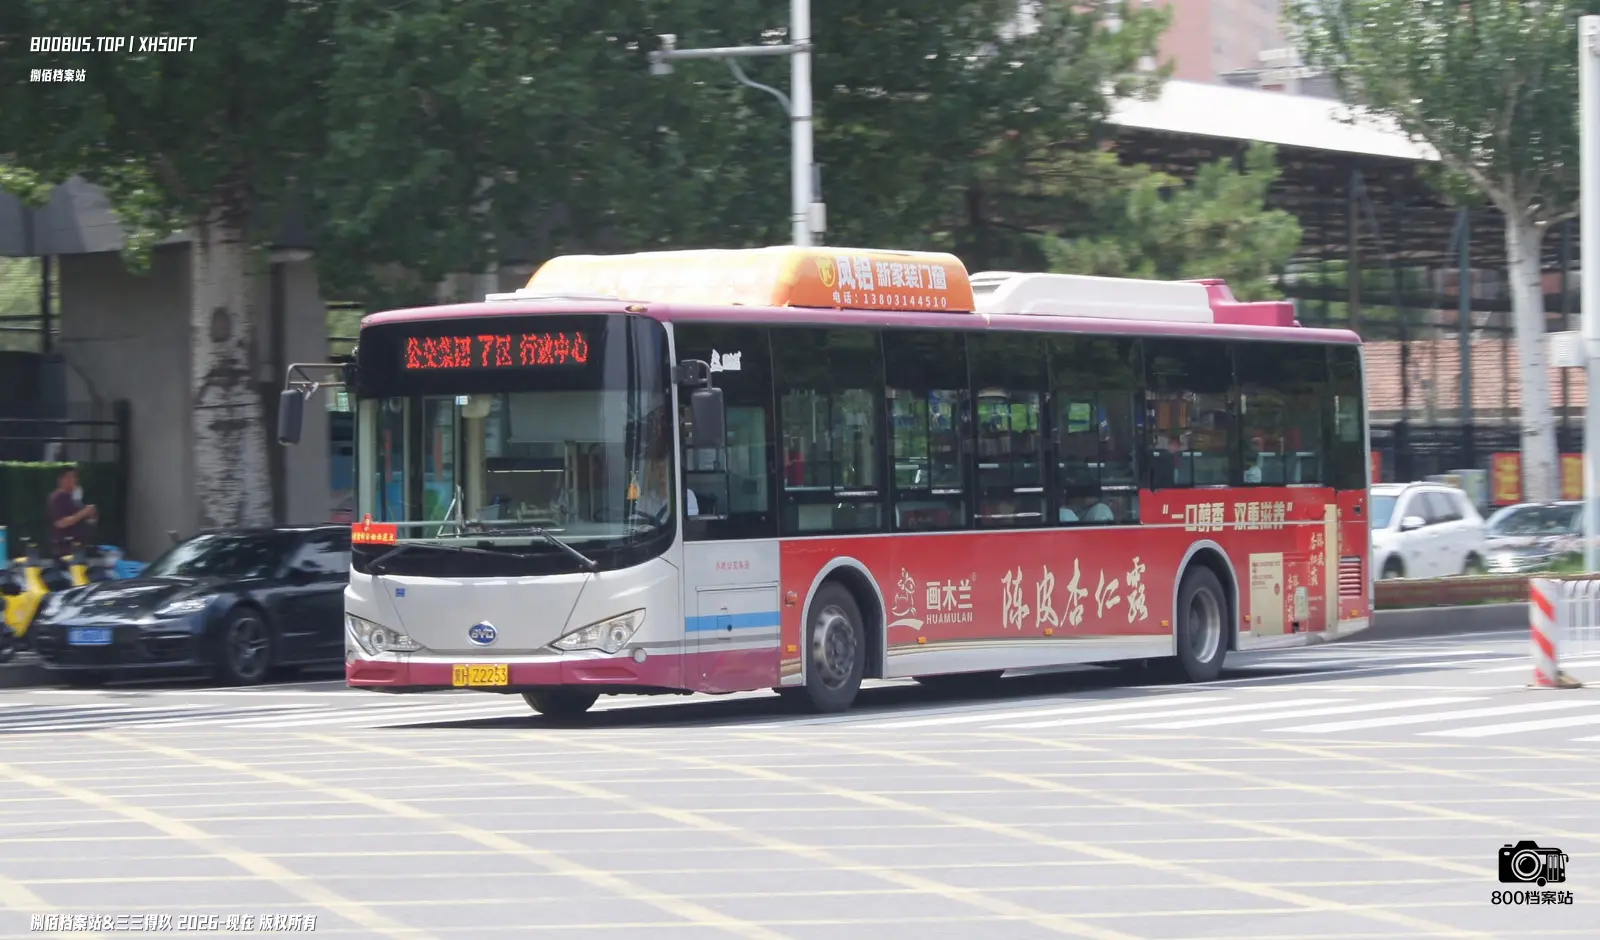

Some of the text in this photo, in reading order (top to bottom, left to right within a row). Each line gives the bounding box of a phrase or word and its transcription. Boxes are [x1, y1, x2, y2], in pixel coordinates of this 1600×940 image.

[876, 262, 947, 289] 新家装门窗
[519, 331, 589, 366] 行政中心
[926, 579, 973, 611] 画木兰
[1001, 556, 1149, 630] 陈皮杏仁露
[926, 612, 973, 625] HUAMULAN
[471, 628, 494, 639] BYD
[472, 666, 507, 683] Z2253
